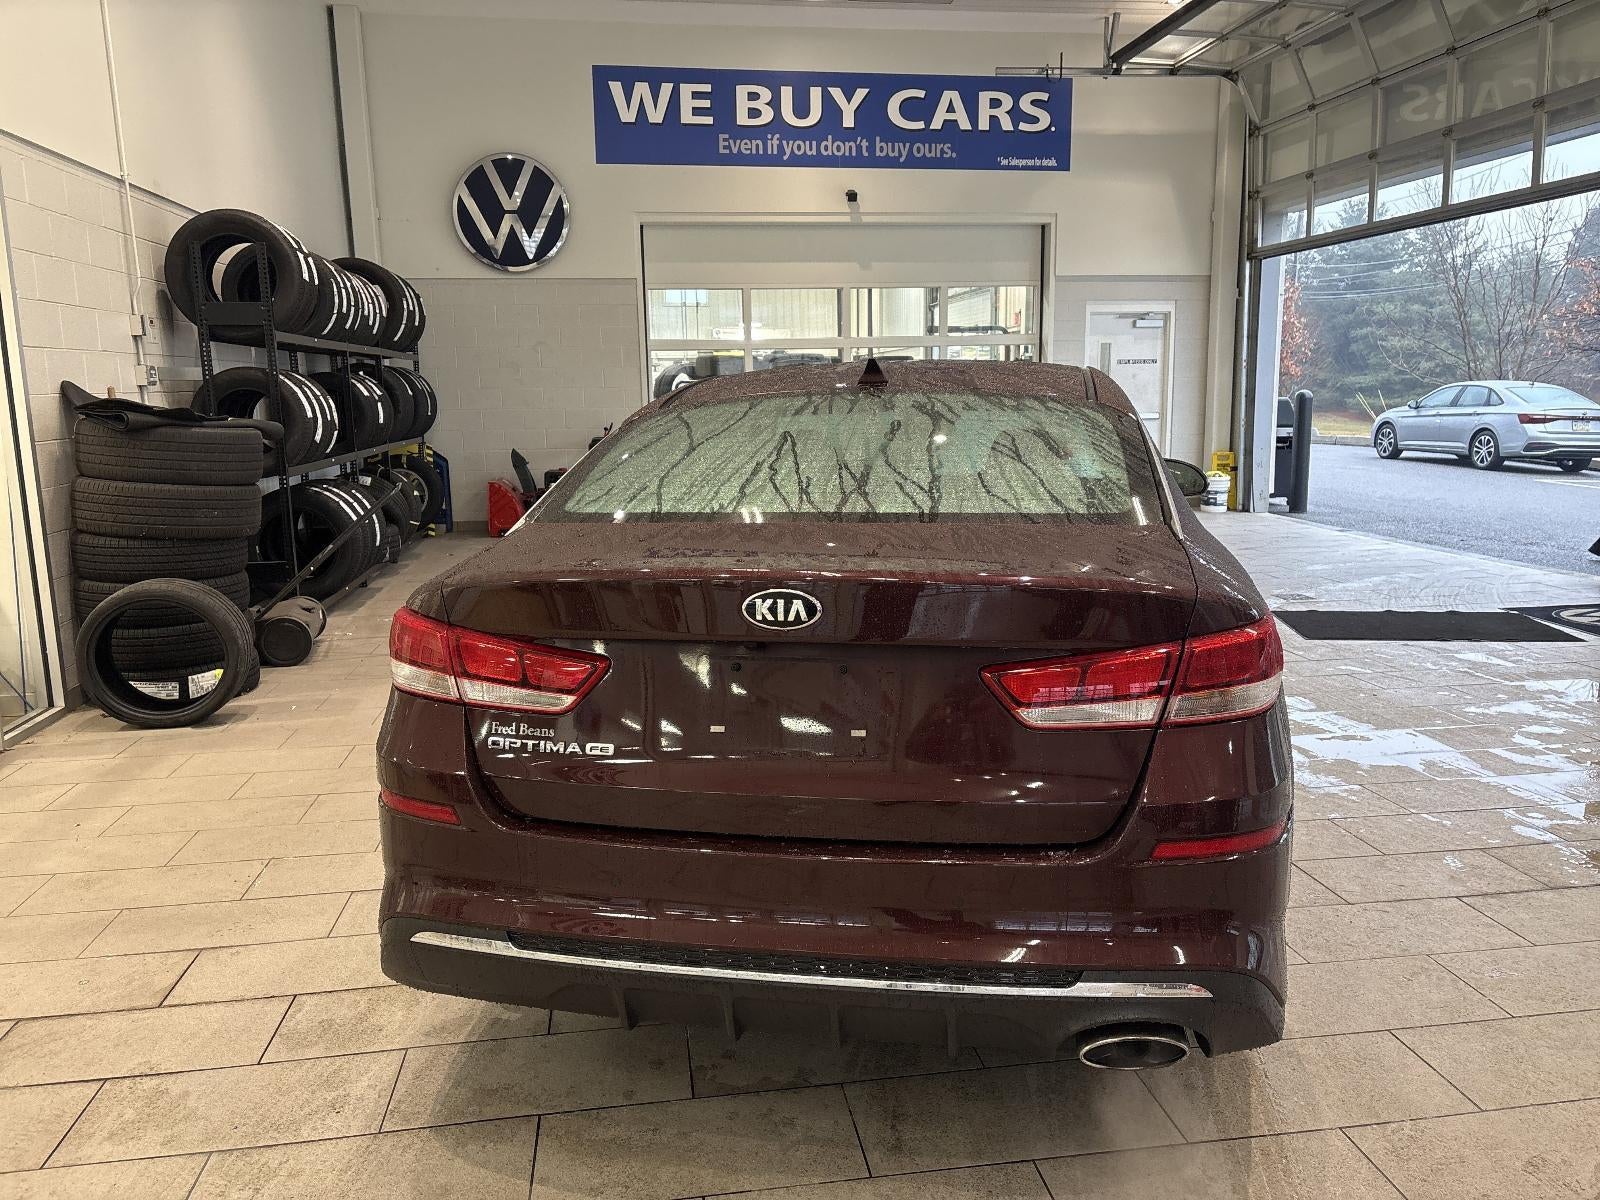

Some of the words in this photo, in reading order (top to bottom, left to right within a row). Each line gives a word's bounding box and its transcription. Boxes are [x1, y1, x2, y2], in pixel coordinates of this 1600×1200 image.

[607, 80, 714, 126] WE
[735, 84, 870, 128] BUY
[887, 88, 1056, 132] CARS.
[718, 133, 763, 155] Even
[767, 133, 780, 155] if
[782, 138, 819, 160] you
[820, 135, 868, 157] don't
[875, 136, 911, 162] buy
[913, 142, 957, 158] ours.
[1000, 156, 1008, 166] See
[1009, 156, 1034, 168] Salesperson
[752, 598, 809, 622] KIA
[491, 721, 516, 735] Fred
[519, 722, 555, 737] Beans
[487, 736, 583, 755] OPTIMA
